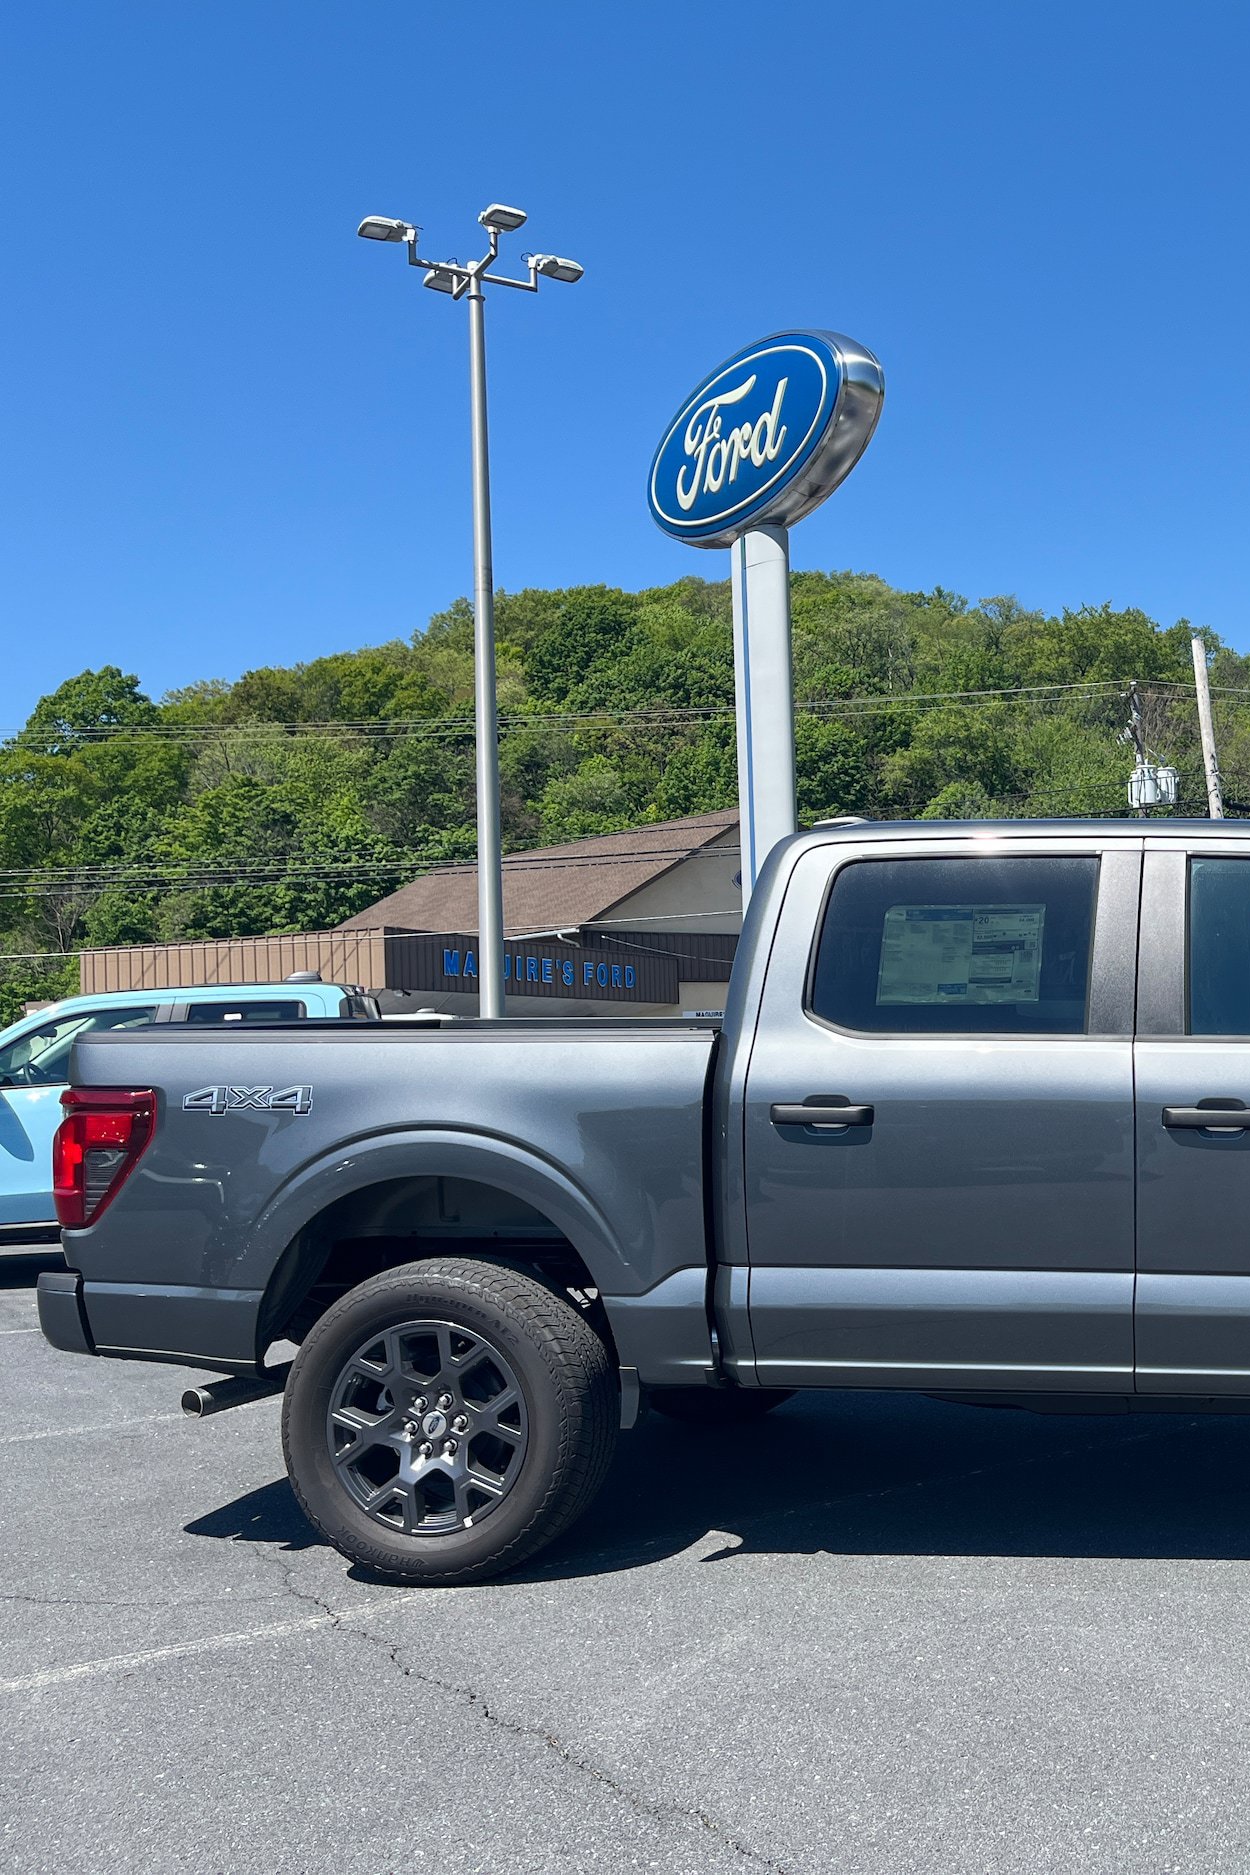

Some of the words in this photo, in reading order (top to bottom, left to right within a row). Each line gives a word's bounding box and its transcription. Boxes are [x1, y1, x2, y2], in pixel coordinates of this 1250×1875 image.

[676, 374, 788, 511] Ford
[443, 949, 574, 986] MAUIRE'S
[583, 961, 636, 989] FORD
